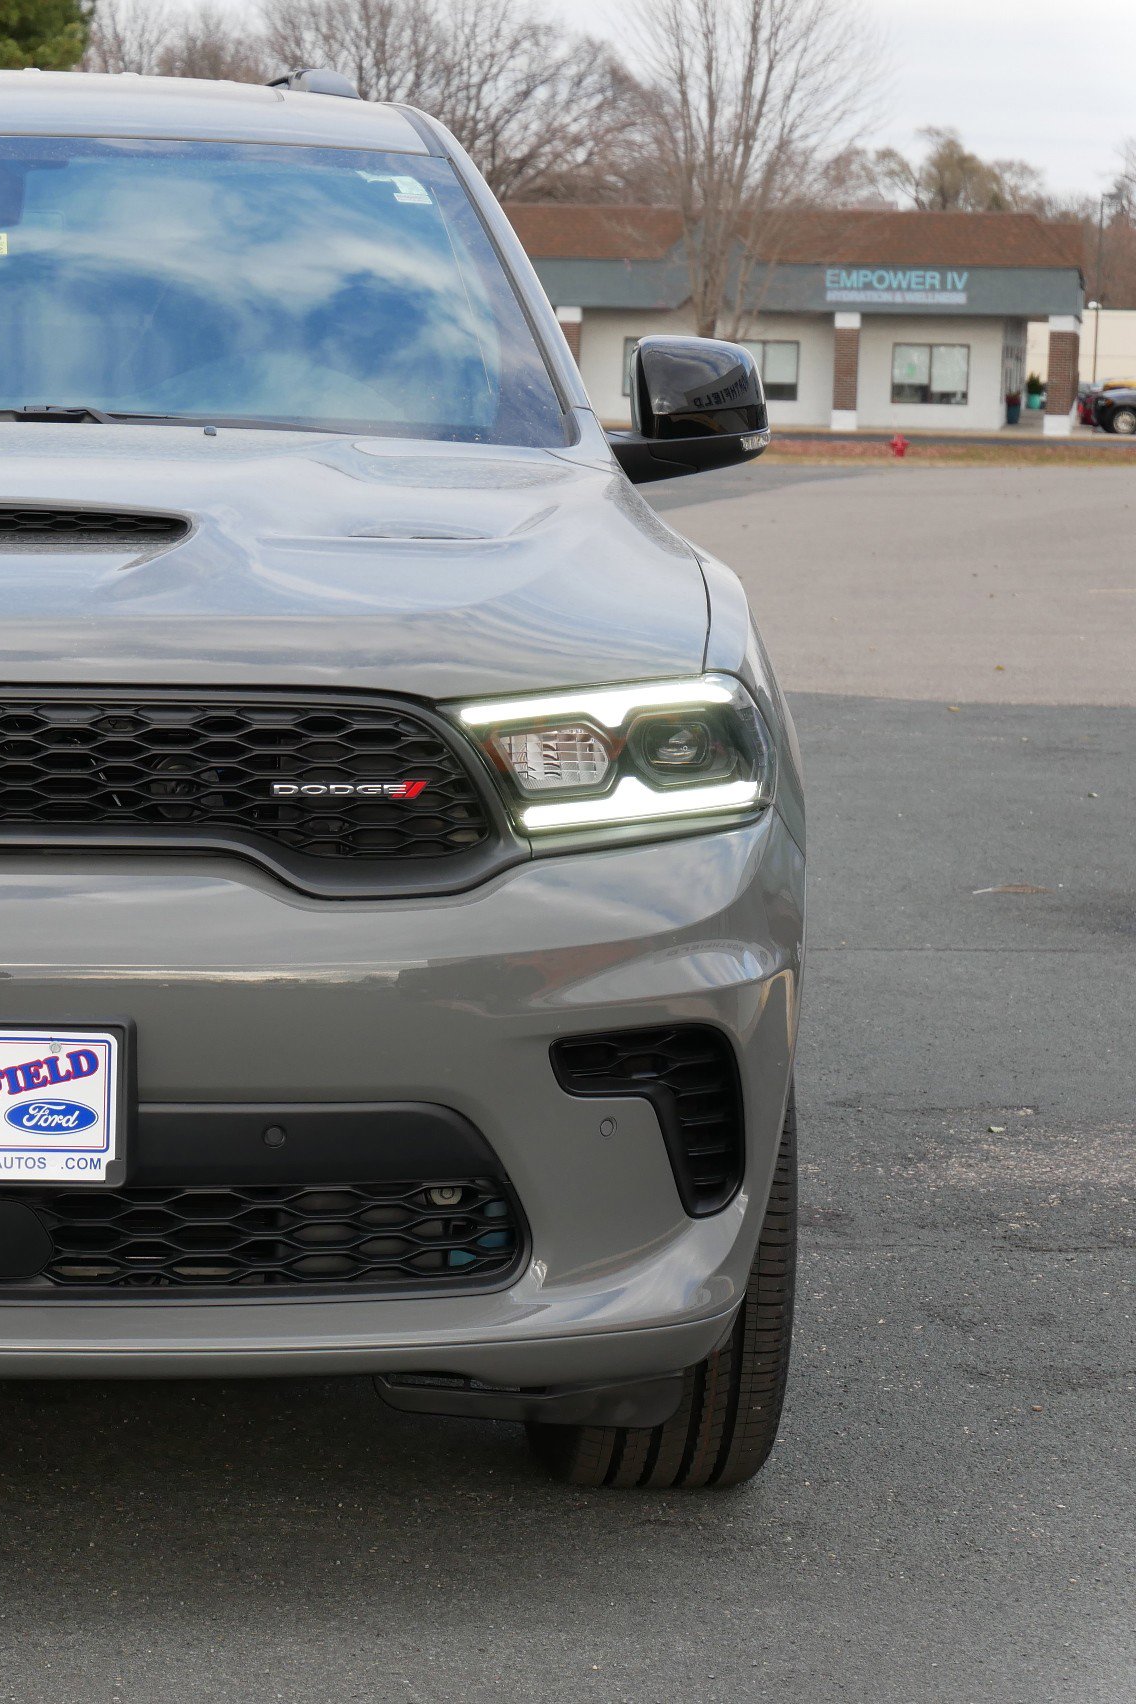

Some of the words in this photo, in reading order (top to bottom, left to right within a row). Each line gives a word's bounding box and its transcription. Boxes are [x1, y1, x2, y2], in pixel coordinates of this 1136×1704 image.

[825, 269, 941, 289] EMPOWER
[946, 271, 969, 290] IV
[273, 784, 407, 796] DODGE
[22, 1103, 79, 1128] Ford
[60, 1157, 102, 1170] .COM
